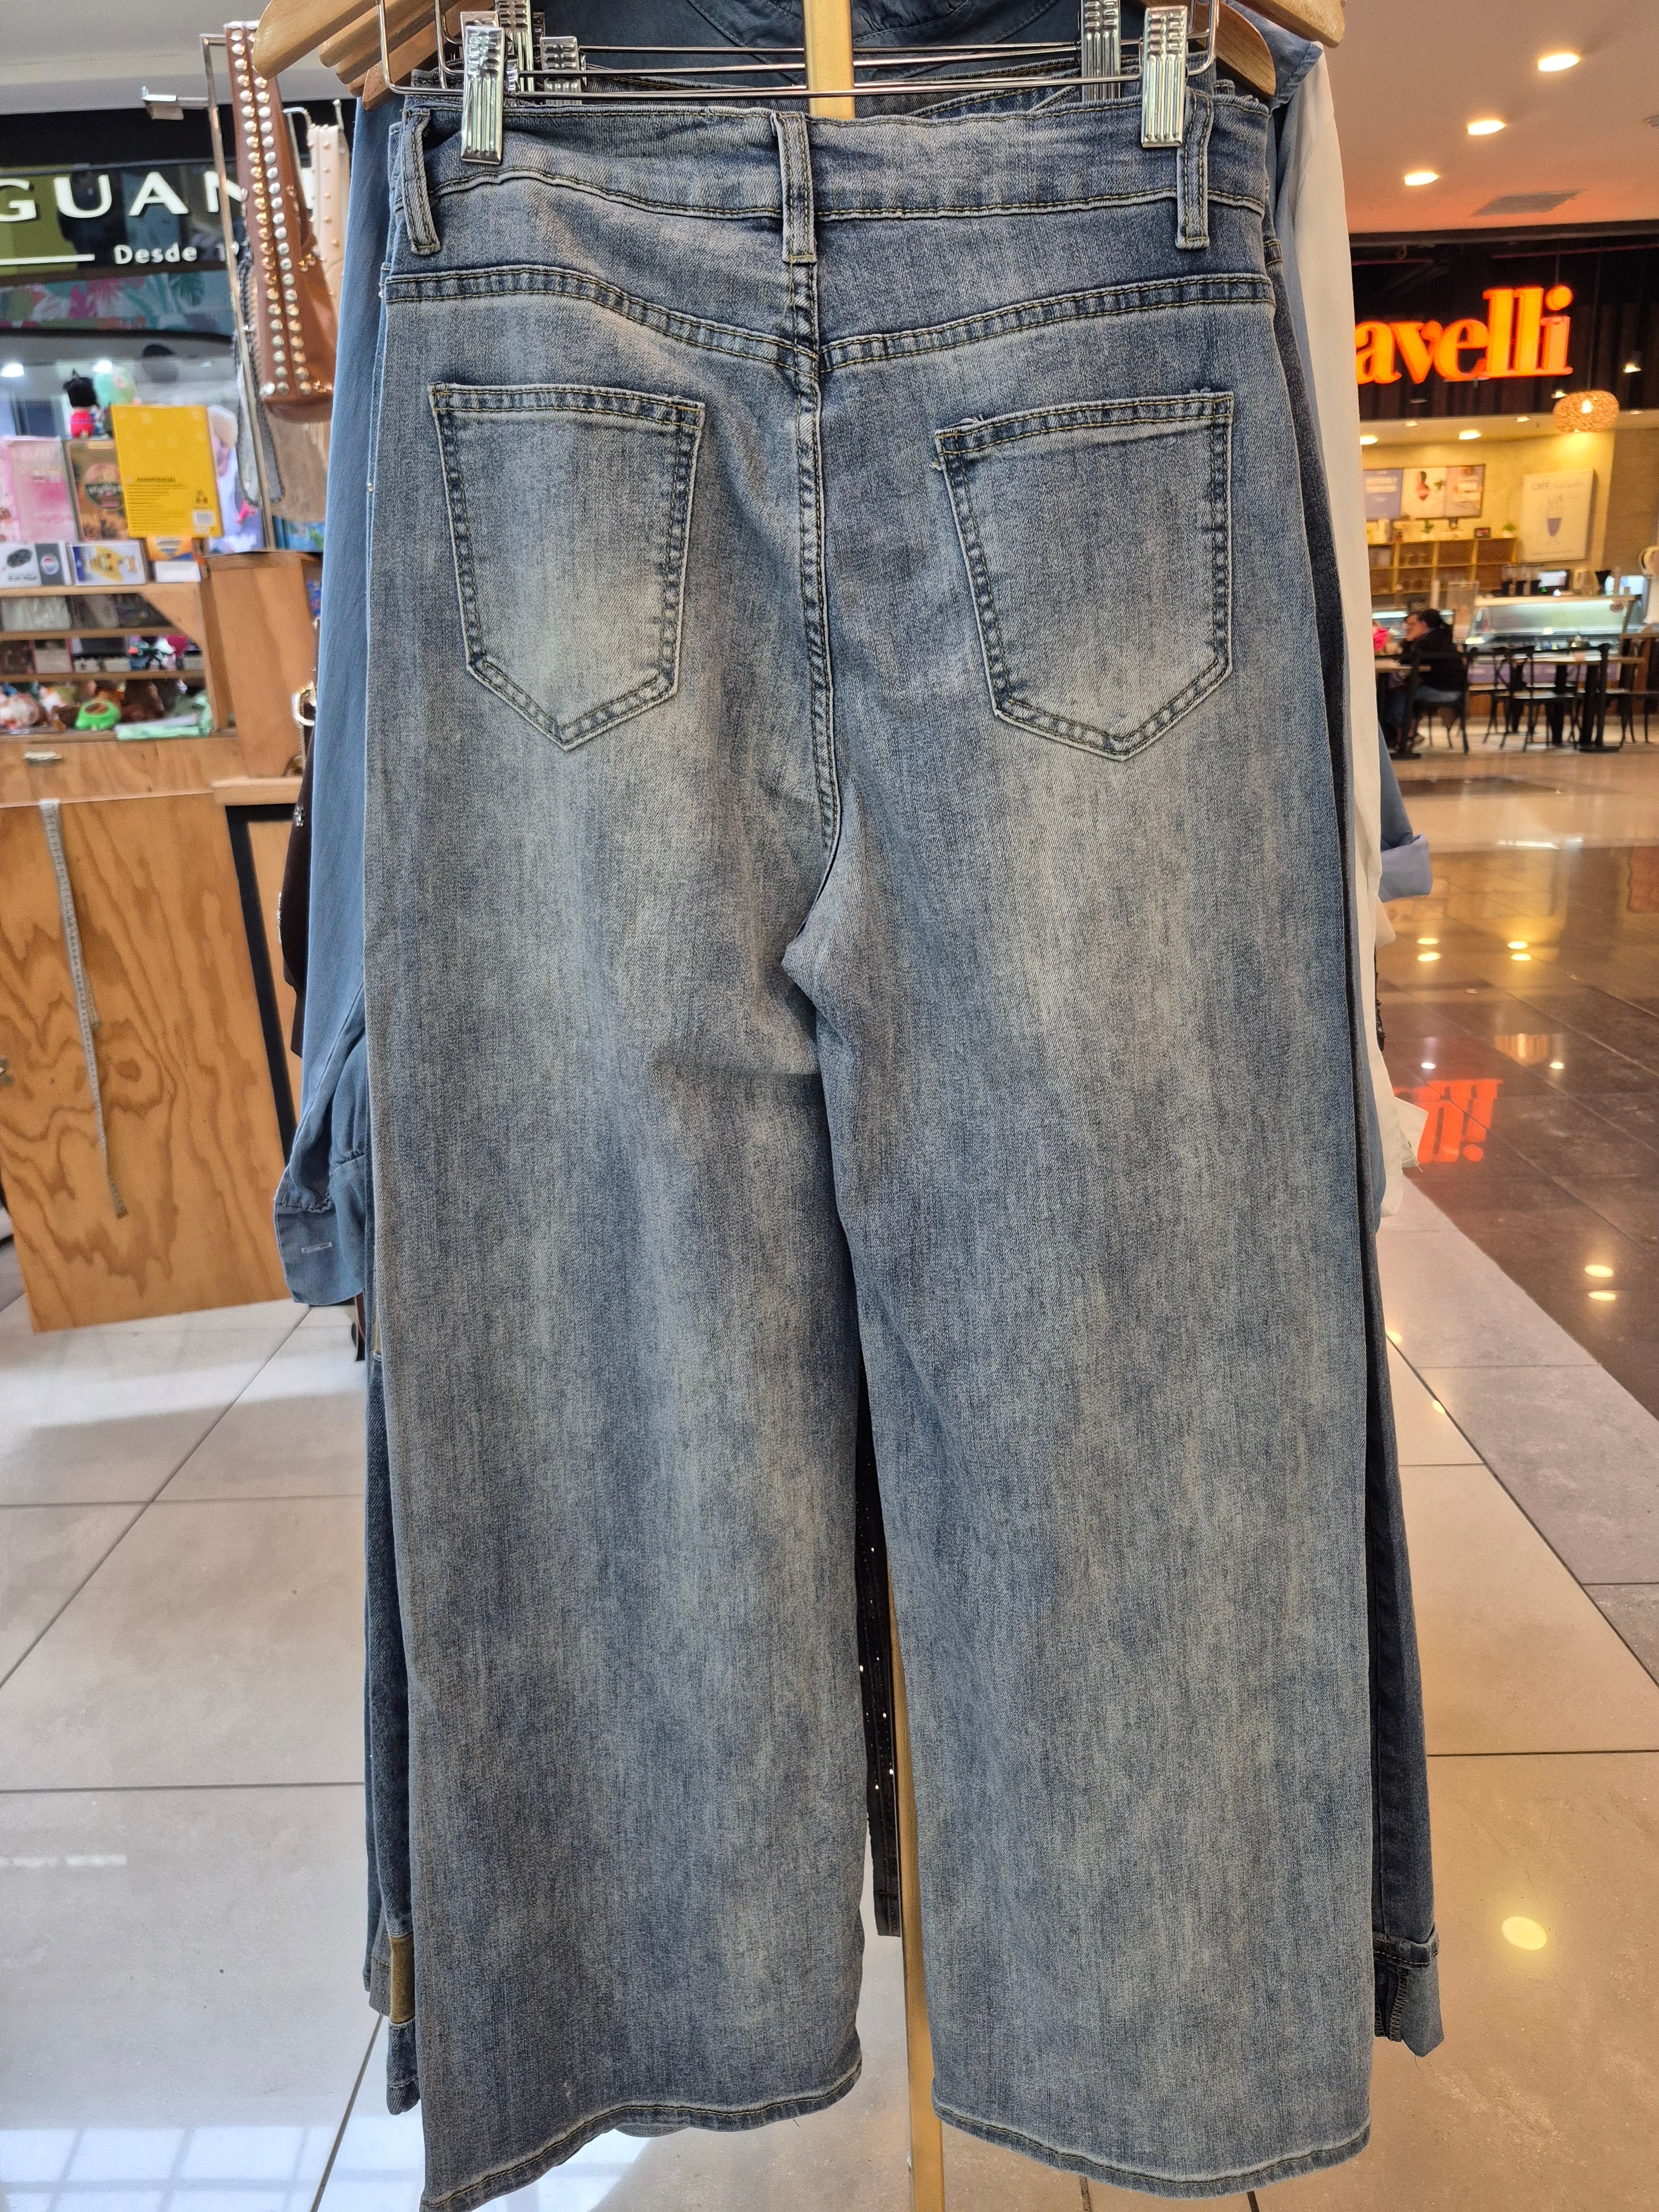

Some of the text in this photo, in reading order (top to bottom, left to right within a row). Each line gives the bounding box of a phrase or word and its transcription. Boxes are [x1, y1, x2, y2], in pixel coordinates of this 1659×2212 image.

[0, 168, 314, 222] GUAN
[114, 242, 197, 265] Desde
[1355, 286, 1573, 384] avelli
